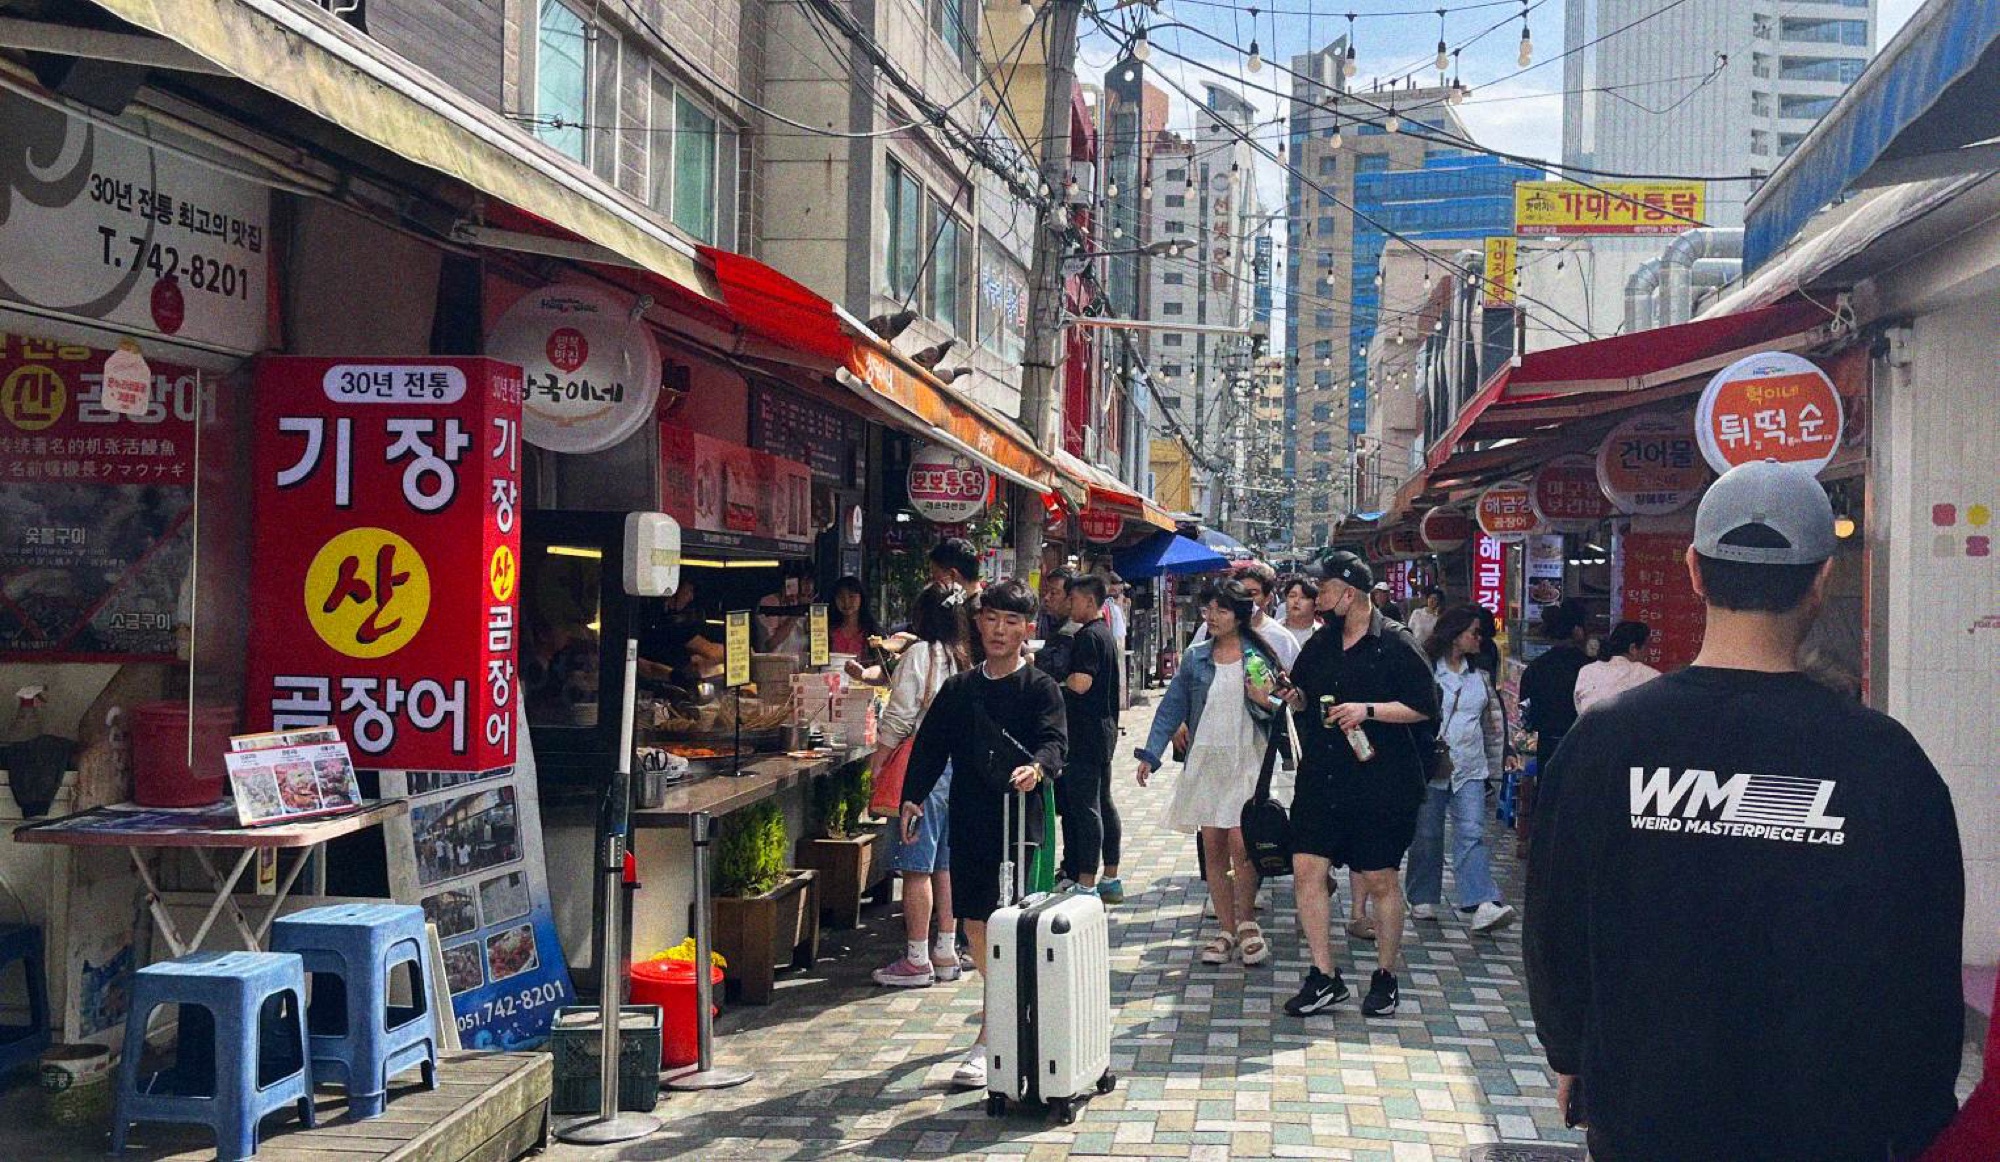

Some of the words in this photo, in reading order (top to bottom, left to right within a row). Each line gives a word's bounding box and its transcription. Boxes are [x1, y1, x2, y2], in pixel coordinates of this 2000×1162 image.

[90, 173, 132, 212] 30년
[137, 187, 174, 226] 전통
[178, 201, 228, 243] 최고의
[231, 218, 262, 254] 맛집
[1558, 190, 1698, 222] 가마치통닭
[98, 225, 248, 301] T.742-8201
[12, 373, 57, 421] 산
[340, 371, 393, 398] 30년
[403, 371, 450, 398] 전통
[1619, 439, 1694, 469] 건어물
[321, 543, 411, 645] 산
[492, 549, 512, 595] 산
[1626, 588, 1665, 604] 떡볶이
[1638, 609, 1664, 623] 순대
[486, 606, 514, 757] 곰장어
[271, 674, 469, 753] 곰장어
[1630, 816, 1682, 832] WEIRD
[1684, 819, 1806, 843] MASTERPIECE
[1806, 829, 1846, 846] LAB
[456, 979, 565, 1032] 051.742-8201
